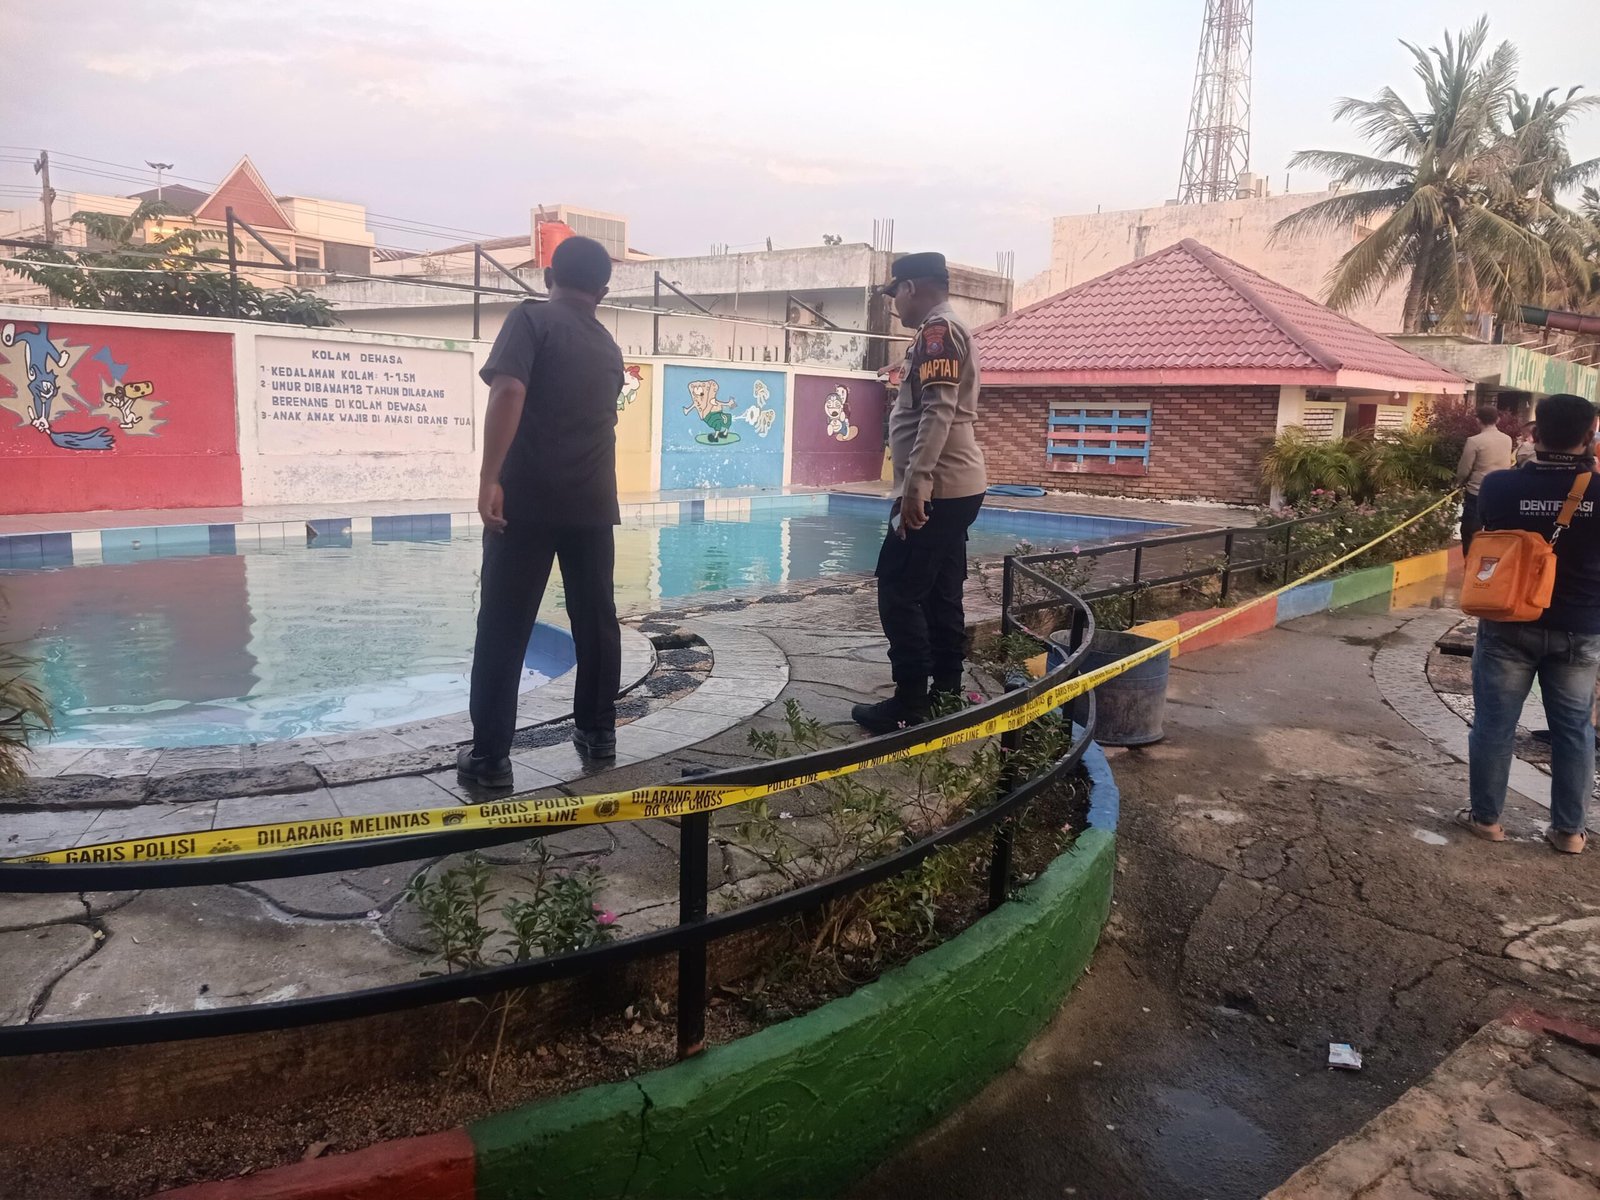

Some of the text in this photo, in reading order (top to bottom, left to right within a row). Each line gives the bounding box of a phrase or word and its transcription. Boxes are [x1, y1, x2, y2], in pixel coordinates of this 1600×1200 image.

[312, 350, 402, 364] KOLAM DEWASA
[271, 366, 335, 379] KEDALAMAN
[271, 381, 302, 392] UMUR
[366, 385, 399, 396] TAHUN
[402, 387, 445, 398] DILARANG
[272, 396, 428, 413] BERENANG DI KOLAM DEWASA
[273, 411, 302, 421] ANAK
[307, 412, 335, 422] ANAK
[340, 413, 369, 423] WAJIB
[372, 414, 380, 423] DI
[384, 414, 413, 424] AWASI
[417, 415, 449, 425] ORANG
[454, 417, 471, 426] TUA
[1520, 500, 1594, 512] IDENTIFASI
[941, 728, 980, 748] POLICE LINE
[767, 772, 818, 793] POLICE LINE
[632, 788, 691, 805] DILARANG
[480, 796, 585, 818] GARIS POLISI
[547, 808, 580, 822] LINE
[257, 821, 344, 846] DILARANG
[350, 811, 431, 835] MELINTAS
[66, 838, 196, 864] GARIS POLISI
